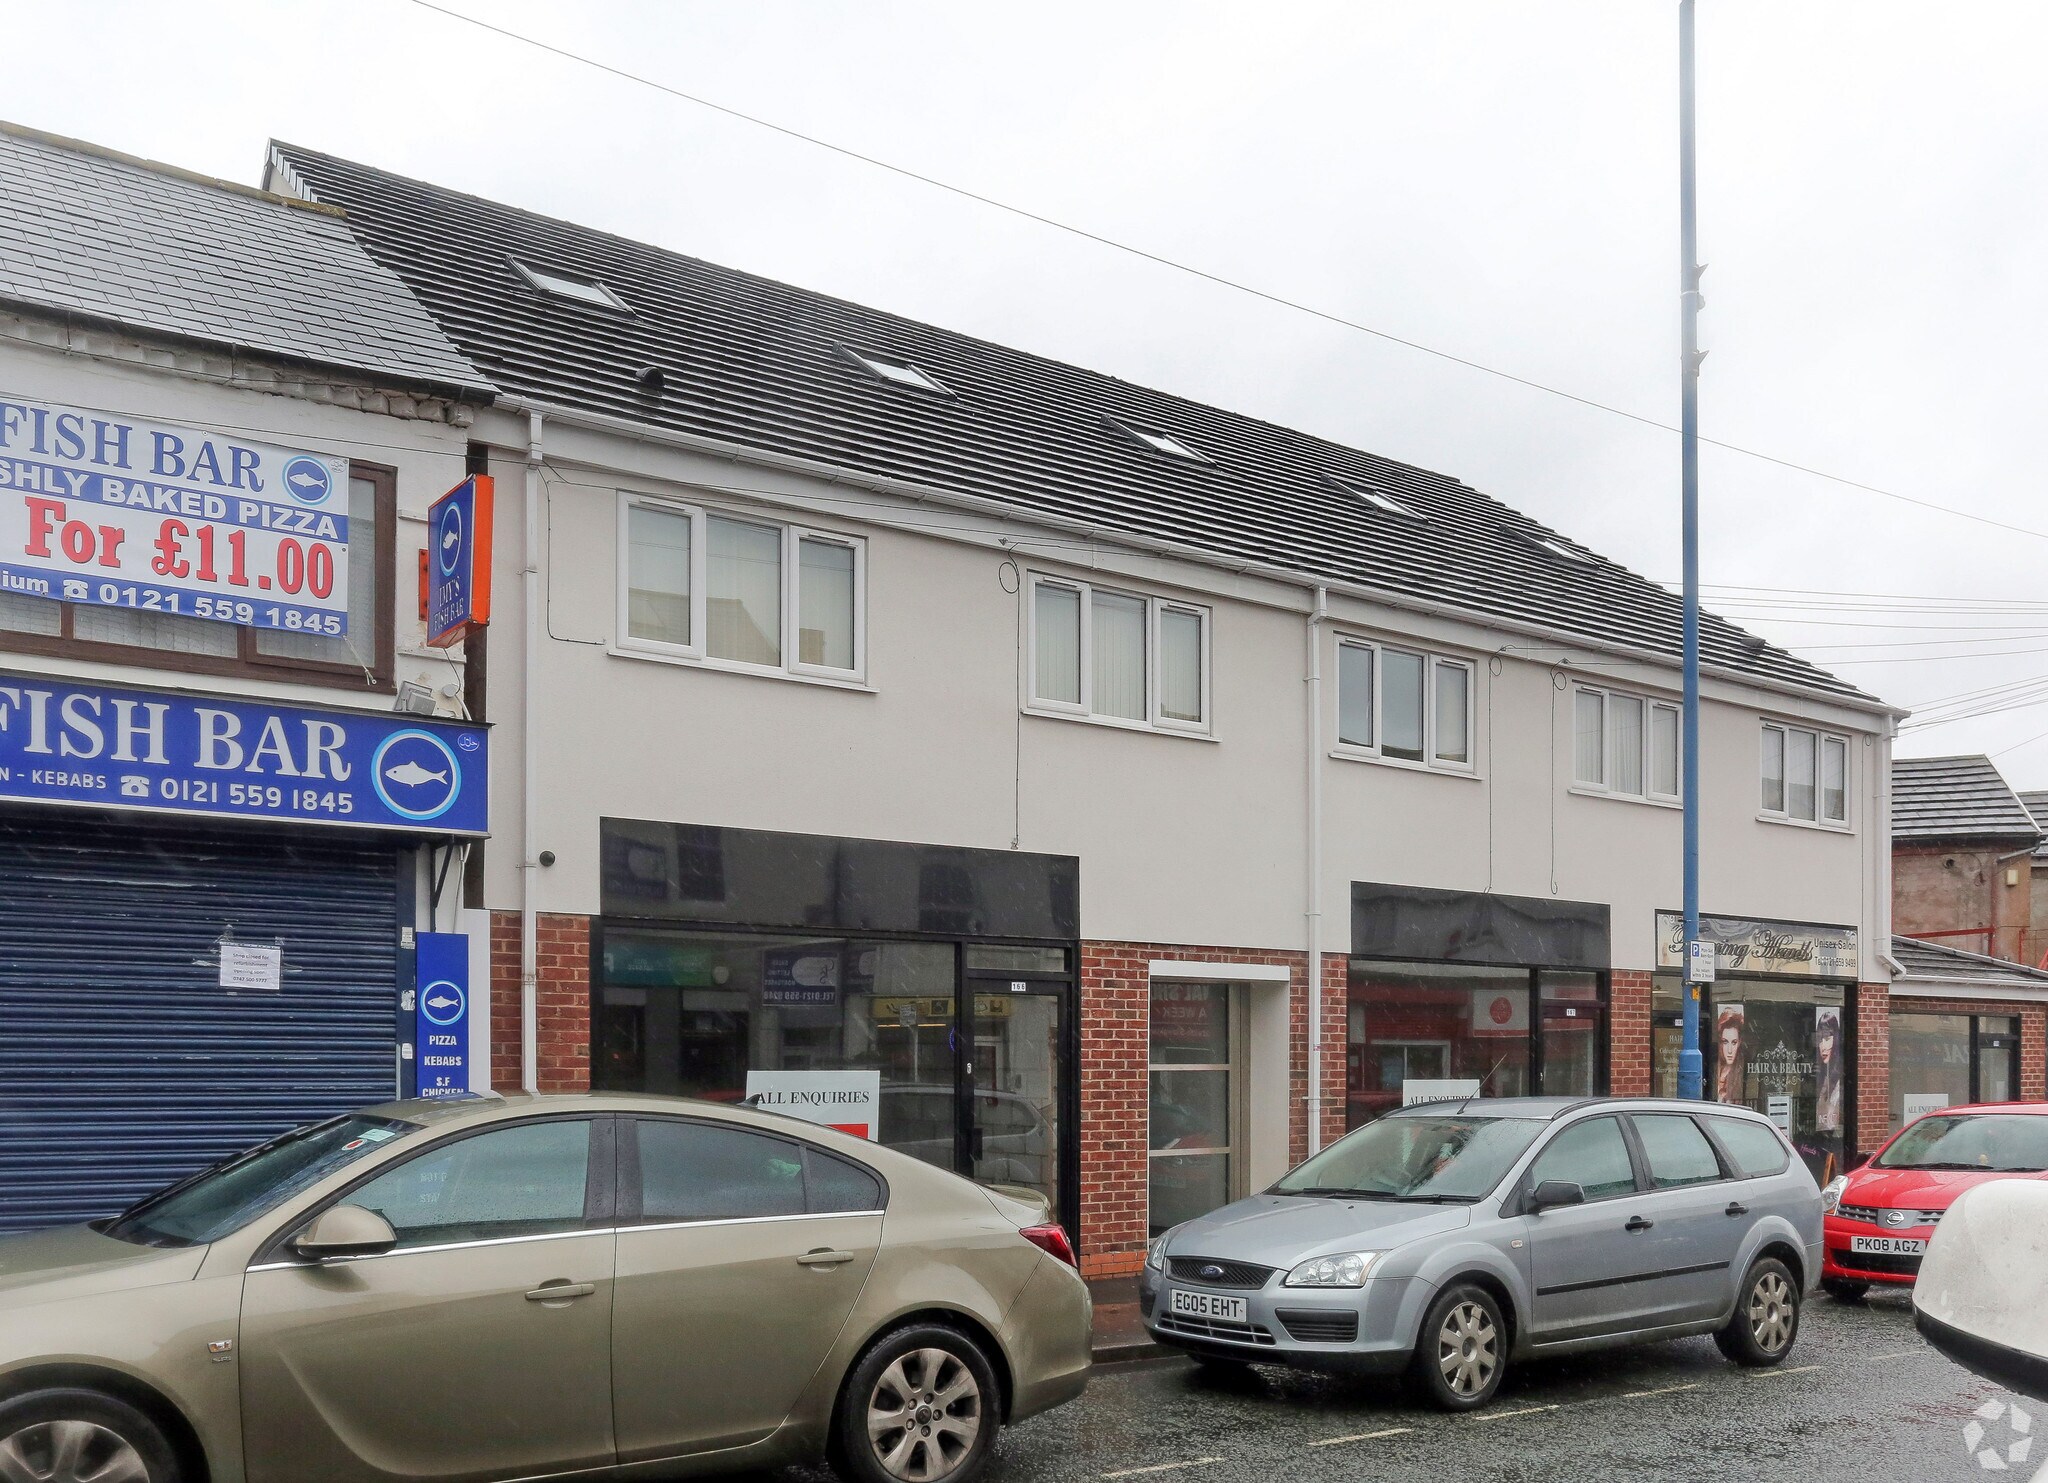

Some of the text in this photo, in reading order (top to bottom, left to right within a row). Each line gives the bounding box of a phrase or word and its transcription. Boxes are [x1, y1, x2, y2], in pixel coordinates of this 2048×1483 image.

[0, 402, 265, 492] FISH BAR
[102, 478, 227, 520] BAKED
[238, 500, 338, 540] PIZZA
[24, 495, 334, 600] For £11.00
[99, 583, 180, 612] 0121
[194, 597, 254, 624] 559
[267, 607, 342, 635] 1845
[194, 707, 353, 783] BAR
[32, 769, 107, 789] KEBABS
[160, 778, 218, 803] 0121
[229, 783, 283, 809] 559
[292, 789, 354, 814] 1845
[1814, 937, 1856, 951] Unisex Salon
[428, 1035, 457, 1046] PIZZA
[424, 1056, 462, 1067] KEBABS
[1747, 1062, 1814, 1074] HAIR & BEAUTY
[436, 1077, 450, 1087] S.F
[422, 1088, 464, 1097] CHICKEN
[758, 1091, 870, 1107] ALL ENQUIRIES
[1856, 1237, 1920, 1253] PK08 AGZ
[1175, 1292, 1240, 1318] EG05 EHT
